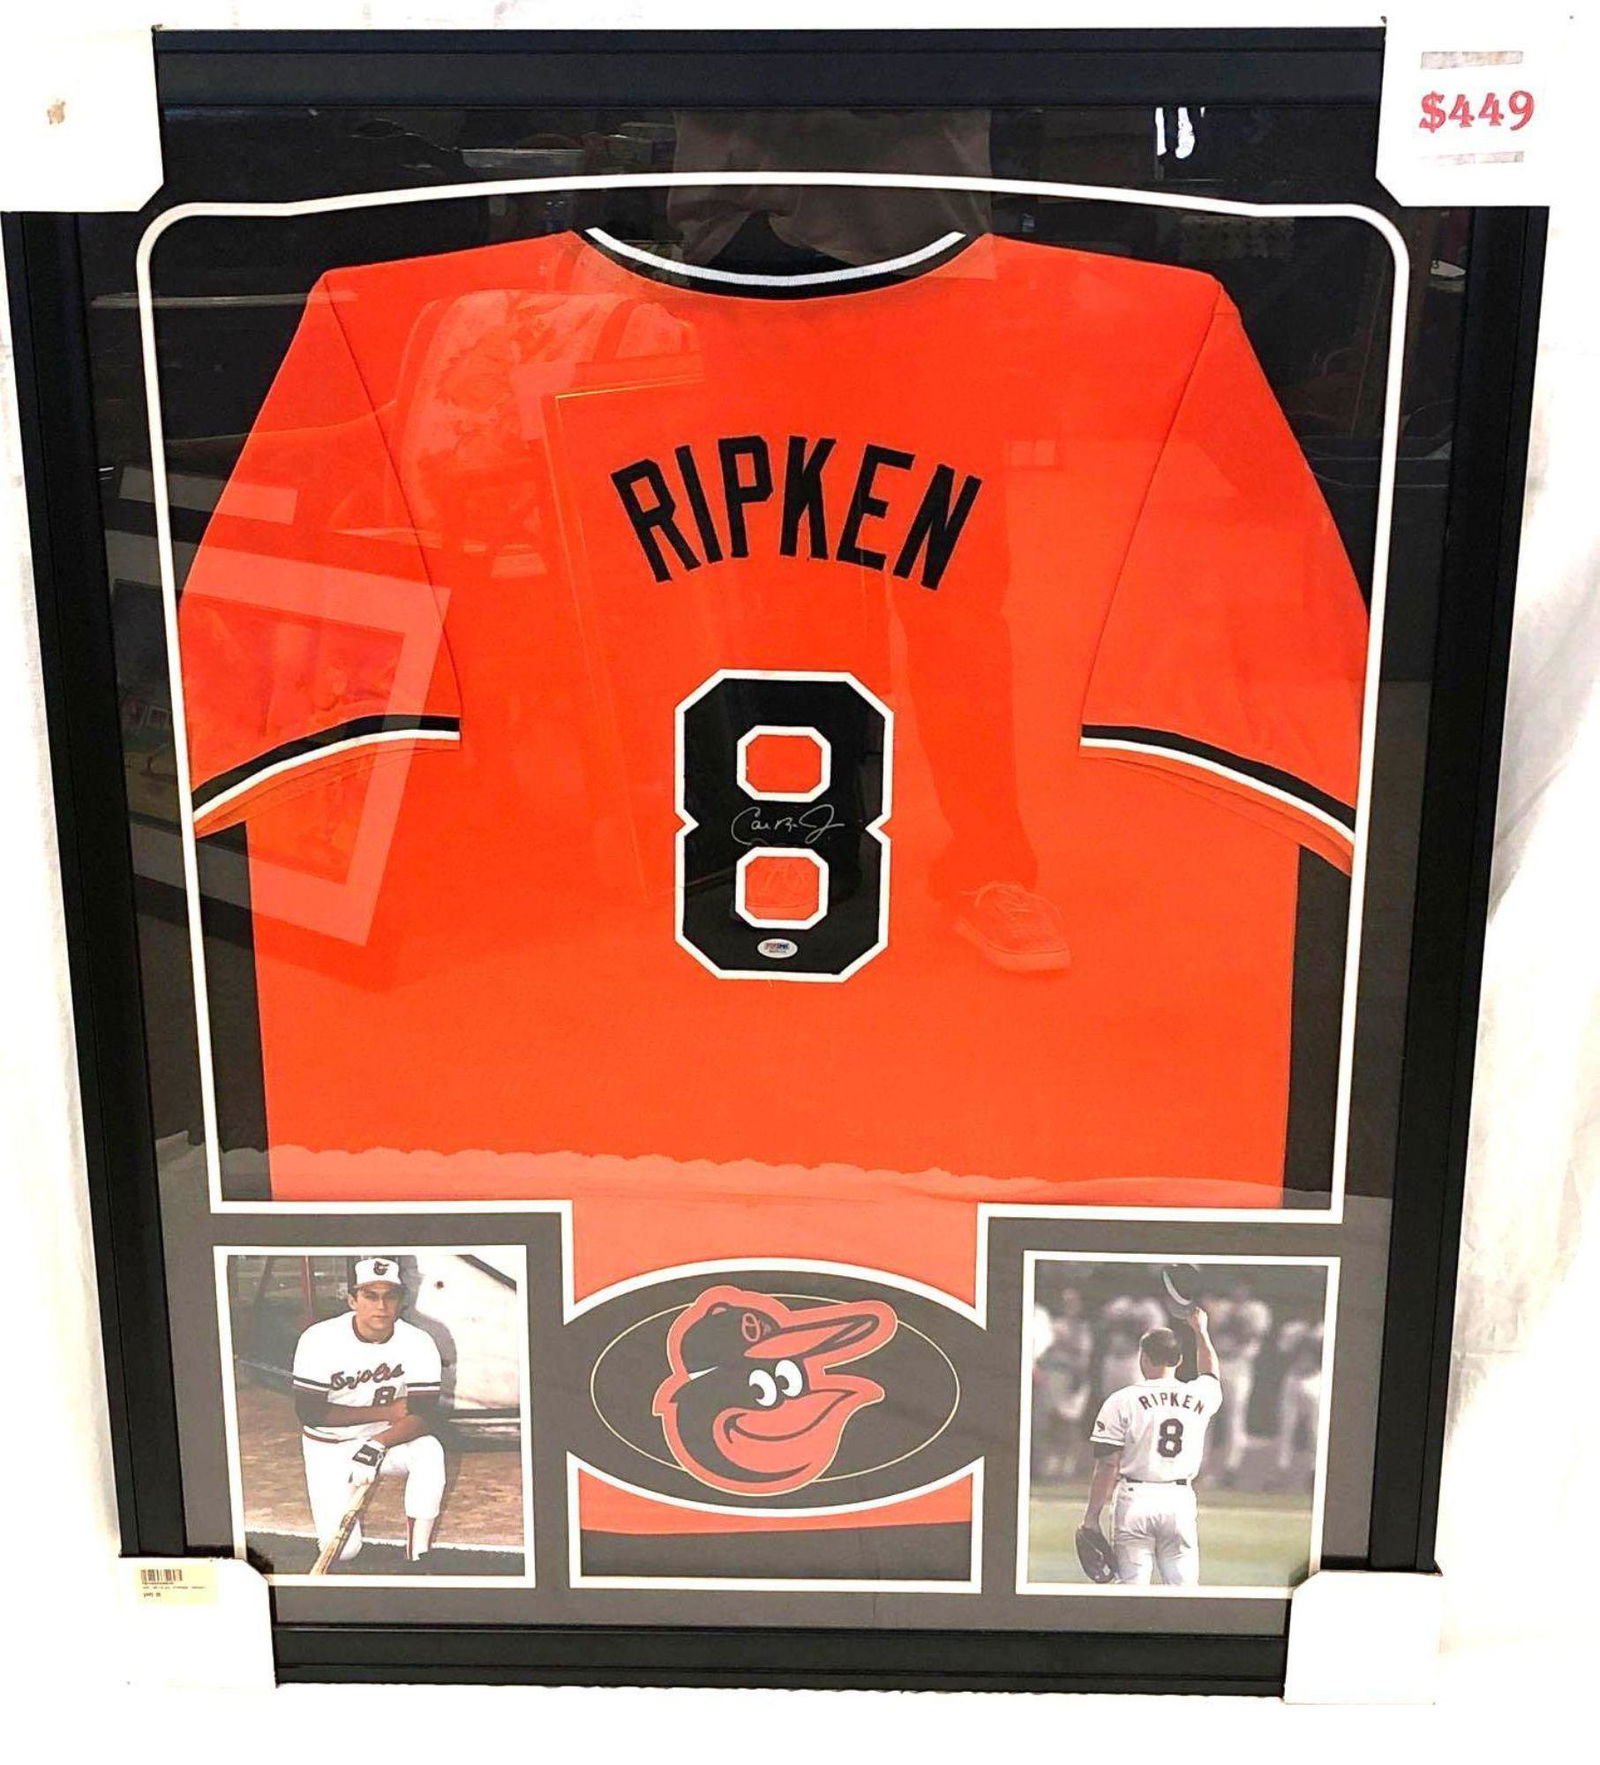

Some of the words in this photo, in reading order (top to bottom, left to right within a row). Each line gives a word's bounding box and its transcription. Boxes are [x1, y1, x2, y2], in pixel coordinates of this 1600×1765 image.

[1418, 90, 1535, 133] $449
[610, 435, 982, 590] RIPKEN
[675, 668, 894, 982] 8
[1139, 1392, 1204, 1414] RIPKEN
[1157, 1418, 1184, 1458] 8
